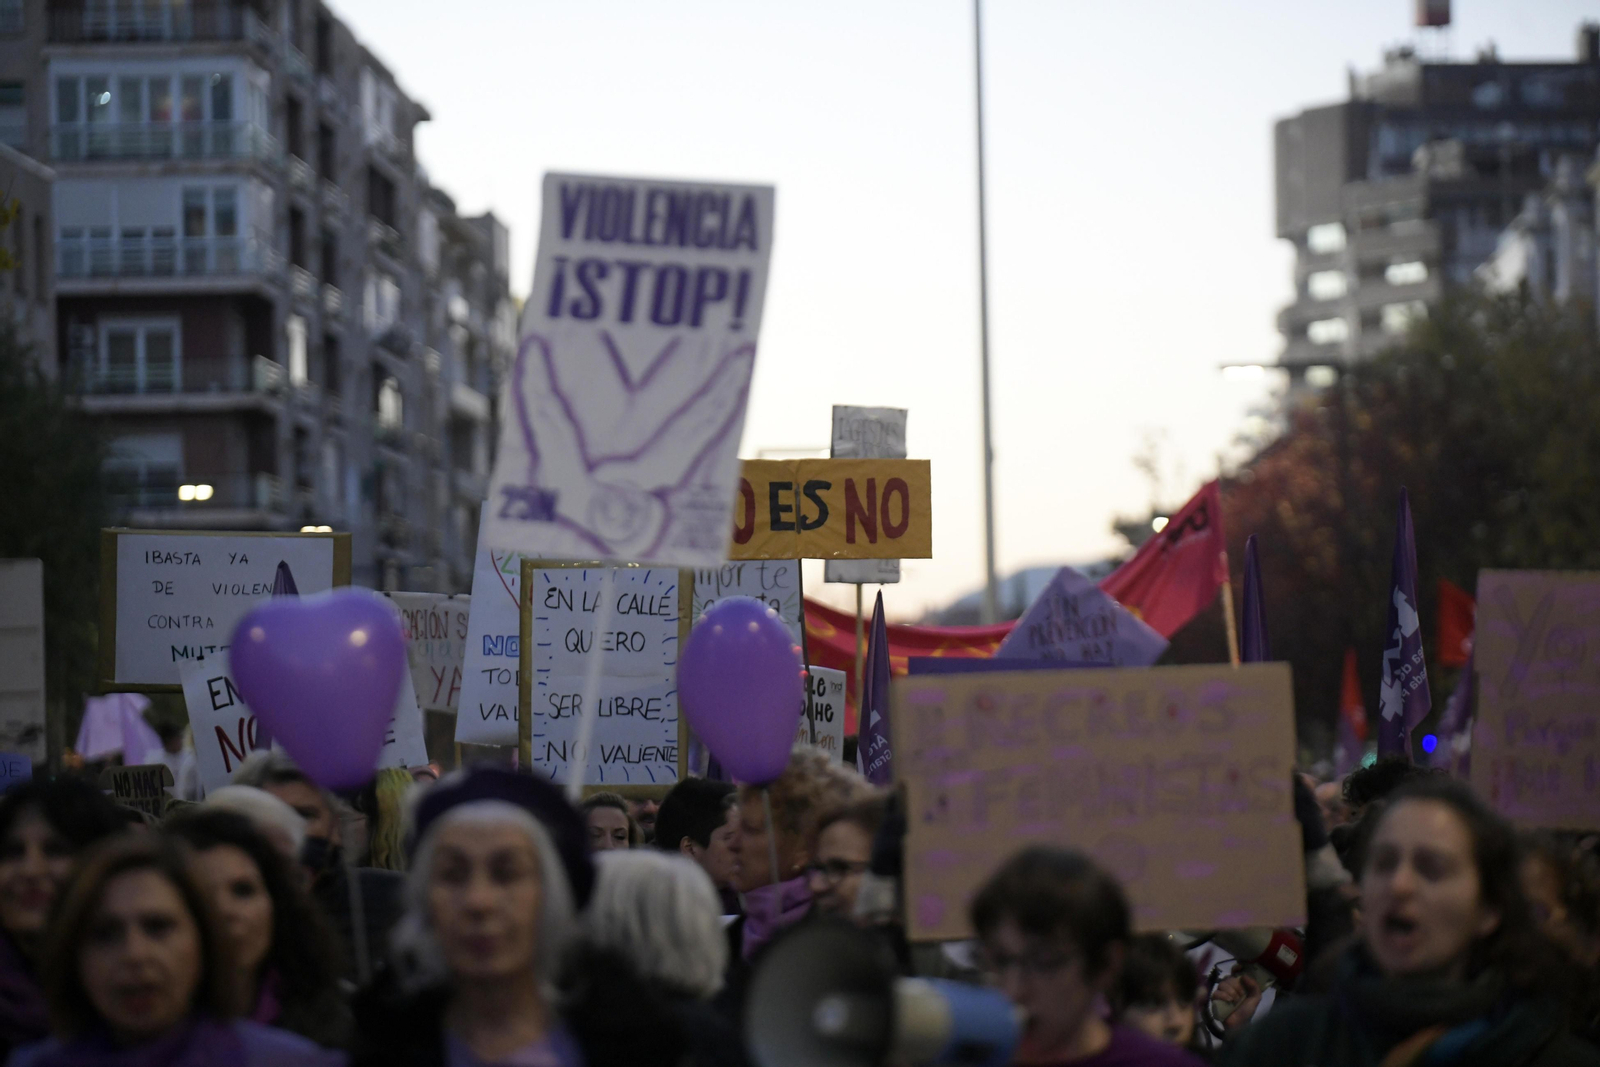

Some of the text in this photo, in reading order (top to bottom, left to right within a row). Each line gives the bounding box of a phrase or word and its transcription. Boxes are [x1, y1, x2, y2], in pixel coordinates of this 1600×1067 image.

[560, 181, 759, 252] VIOLENCIA
[546, 255, 753, 331] ¡STOP!
[769, 480, 832, 532] ES
[844, 477, 910, 544] NO
[228, 552, 249, 565] YA
[152, 580, 273, 595] DE VIOLEN
[544, 587, 573, 611] EN
[616, 593, 671, 616] CALLE
[147, 614, 214, 629] CONTRA
[565, 628, 646, 654] QUERO
[549, 693, 583, 719] SER
[113, 771, 131, 798] NO
